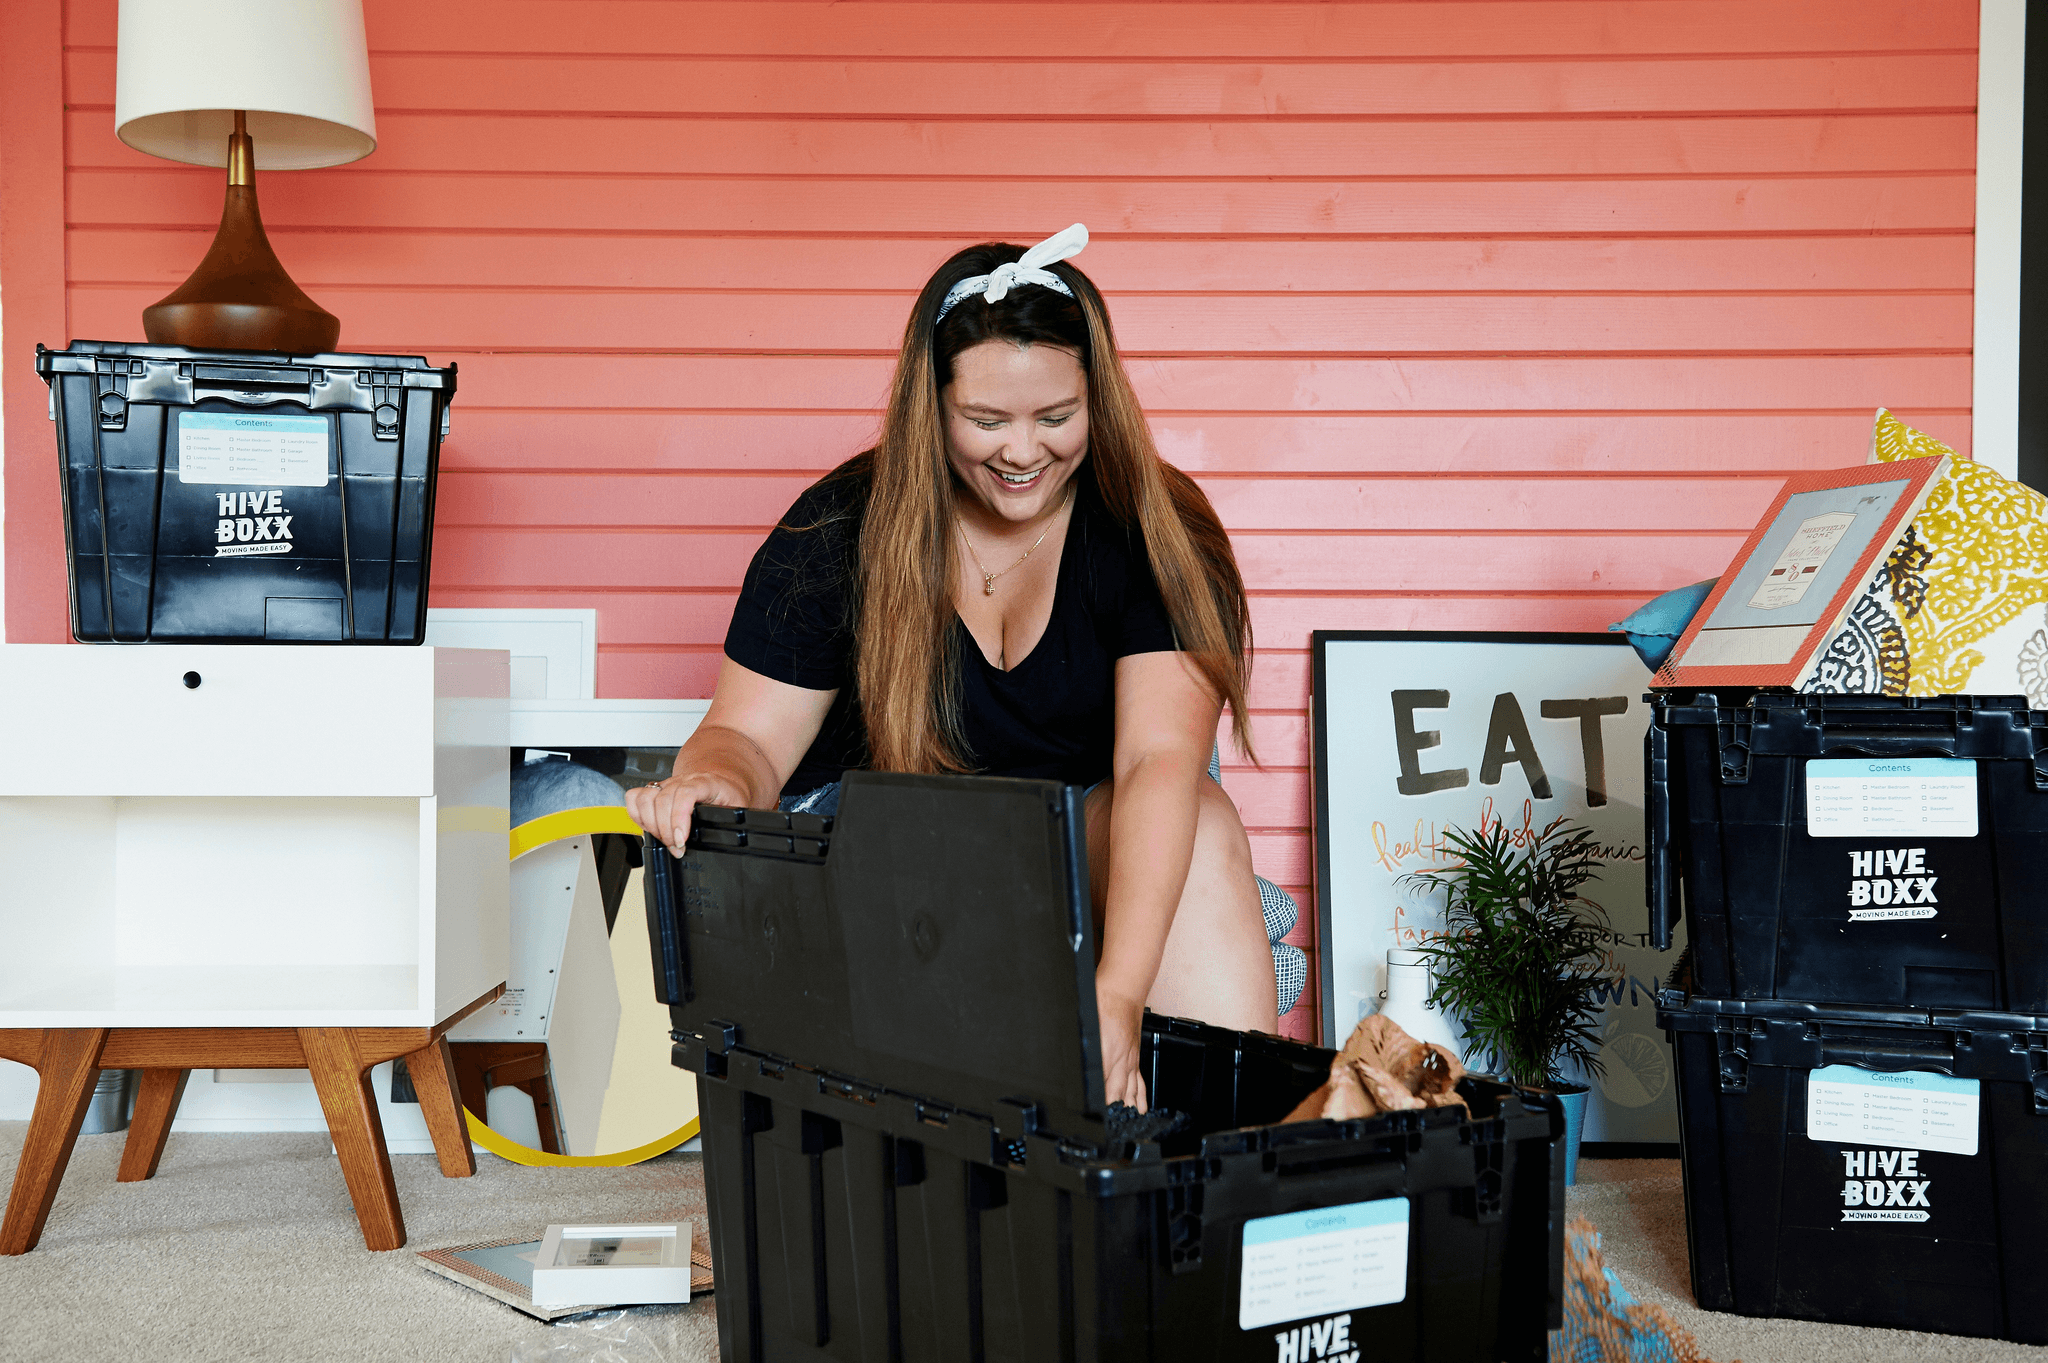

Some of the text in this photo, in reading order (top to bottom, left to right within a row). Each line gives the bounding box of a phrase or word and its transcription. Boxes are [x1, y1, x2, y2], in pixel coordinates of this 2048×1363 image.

[235, 419, 273, 427] Contents
[215, 490, 283, 516] HIVE
[214, 515, 294, 543] BOXX
[1391, 689, 1628, 808] EAT
[1869, 764, 1911, 772] Contents
[1848, 848, 1926, 877] HIVE
[1847, 877, 1938, 906] BOXX
[1871, 1073, 1914, 1084] Contents
[1841, 1151, 1919, 1177] HIVE
[1840, 1180, 1931, 1207] BOXX
[1274, 1313, 1351, 1363] HIVE
